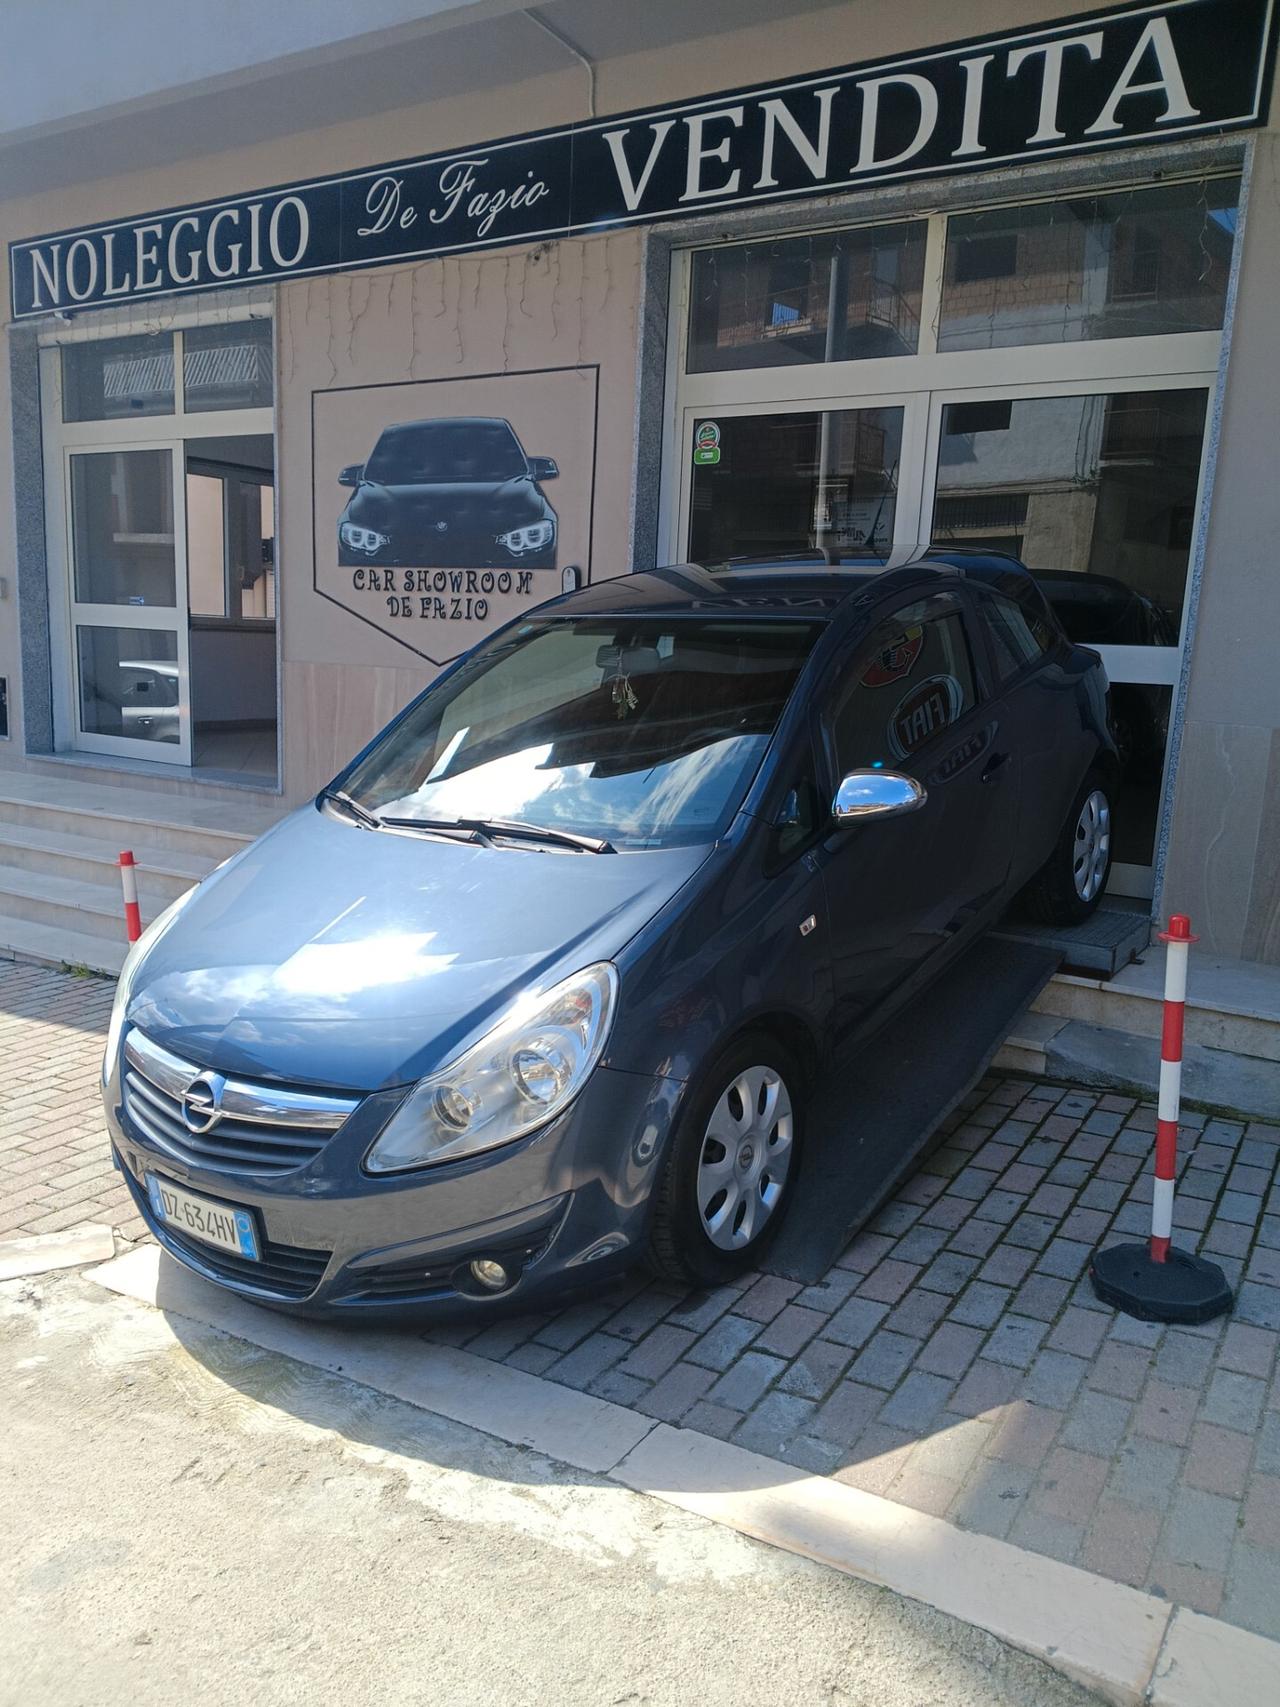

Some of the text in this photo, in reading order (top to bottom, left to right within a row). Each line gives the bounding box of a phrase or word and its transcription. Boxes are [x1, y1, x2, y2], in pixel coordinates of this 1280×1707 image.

[29, 16, 1201, 308] NOLEGGIO De Fazio VENDITA
[352, 568, 534, 595] CAR SHOWROOM
[386, 595, 489, 621] DE FAZIO
